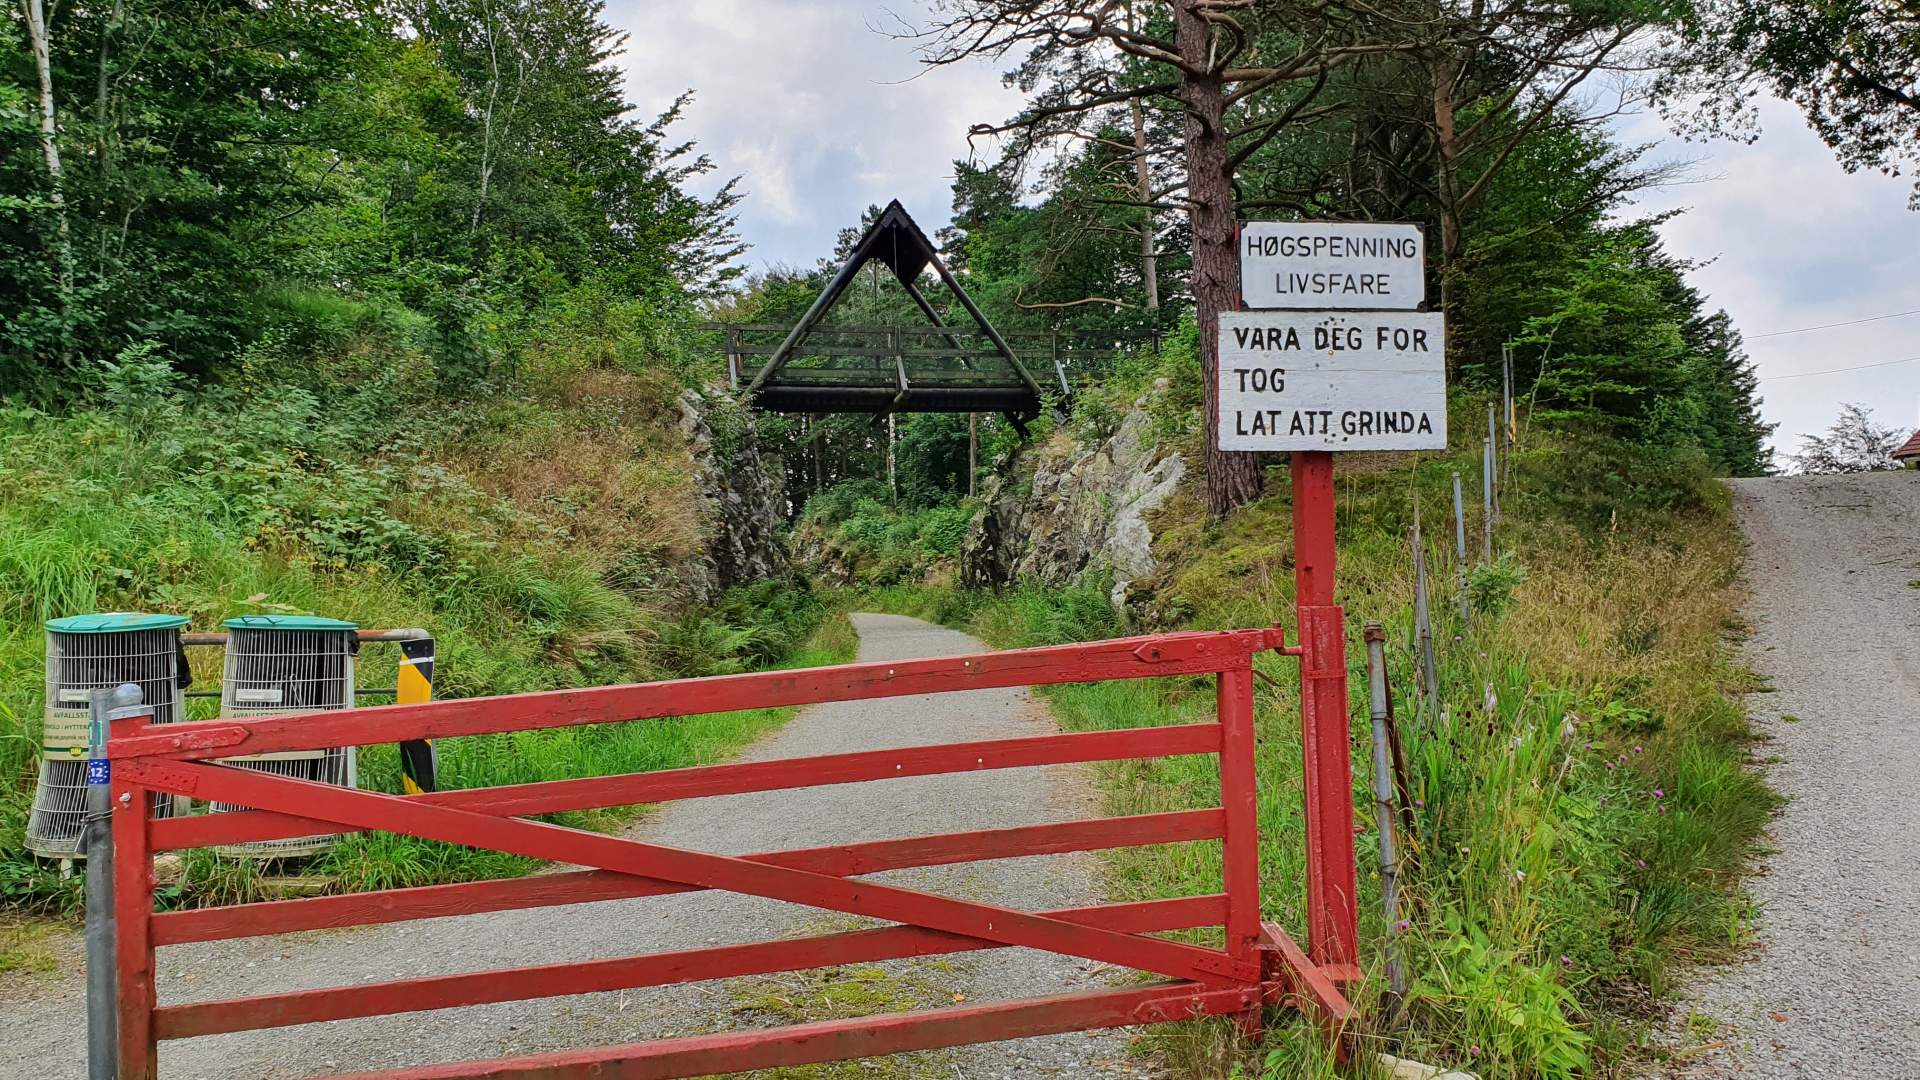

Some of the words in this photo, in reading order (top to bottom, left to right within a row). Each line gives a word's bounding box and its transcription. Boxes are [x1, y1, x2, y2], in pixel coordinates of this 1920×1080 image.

[1247, 236, 1416, 259] HØGSPENNING
[1275, 273, 1391, 295] LIVSFARE
[1233, 327, 1301, 350] VARA
[1314, 327, 1362, 351] DEG
[1377, 327, 1429, 352] FOR
[1234, 368, 1286, 393] TOG
[1236, 410, 1282, 436] LAT
[1289, 410, 1336, 436] ATT
[1341, 410, 1433, 436] GRINDA
[90, 767, 103, 778] 12
